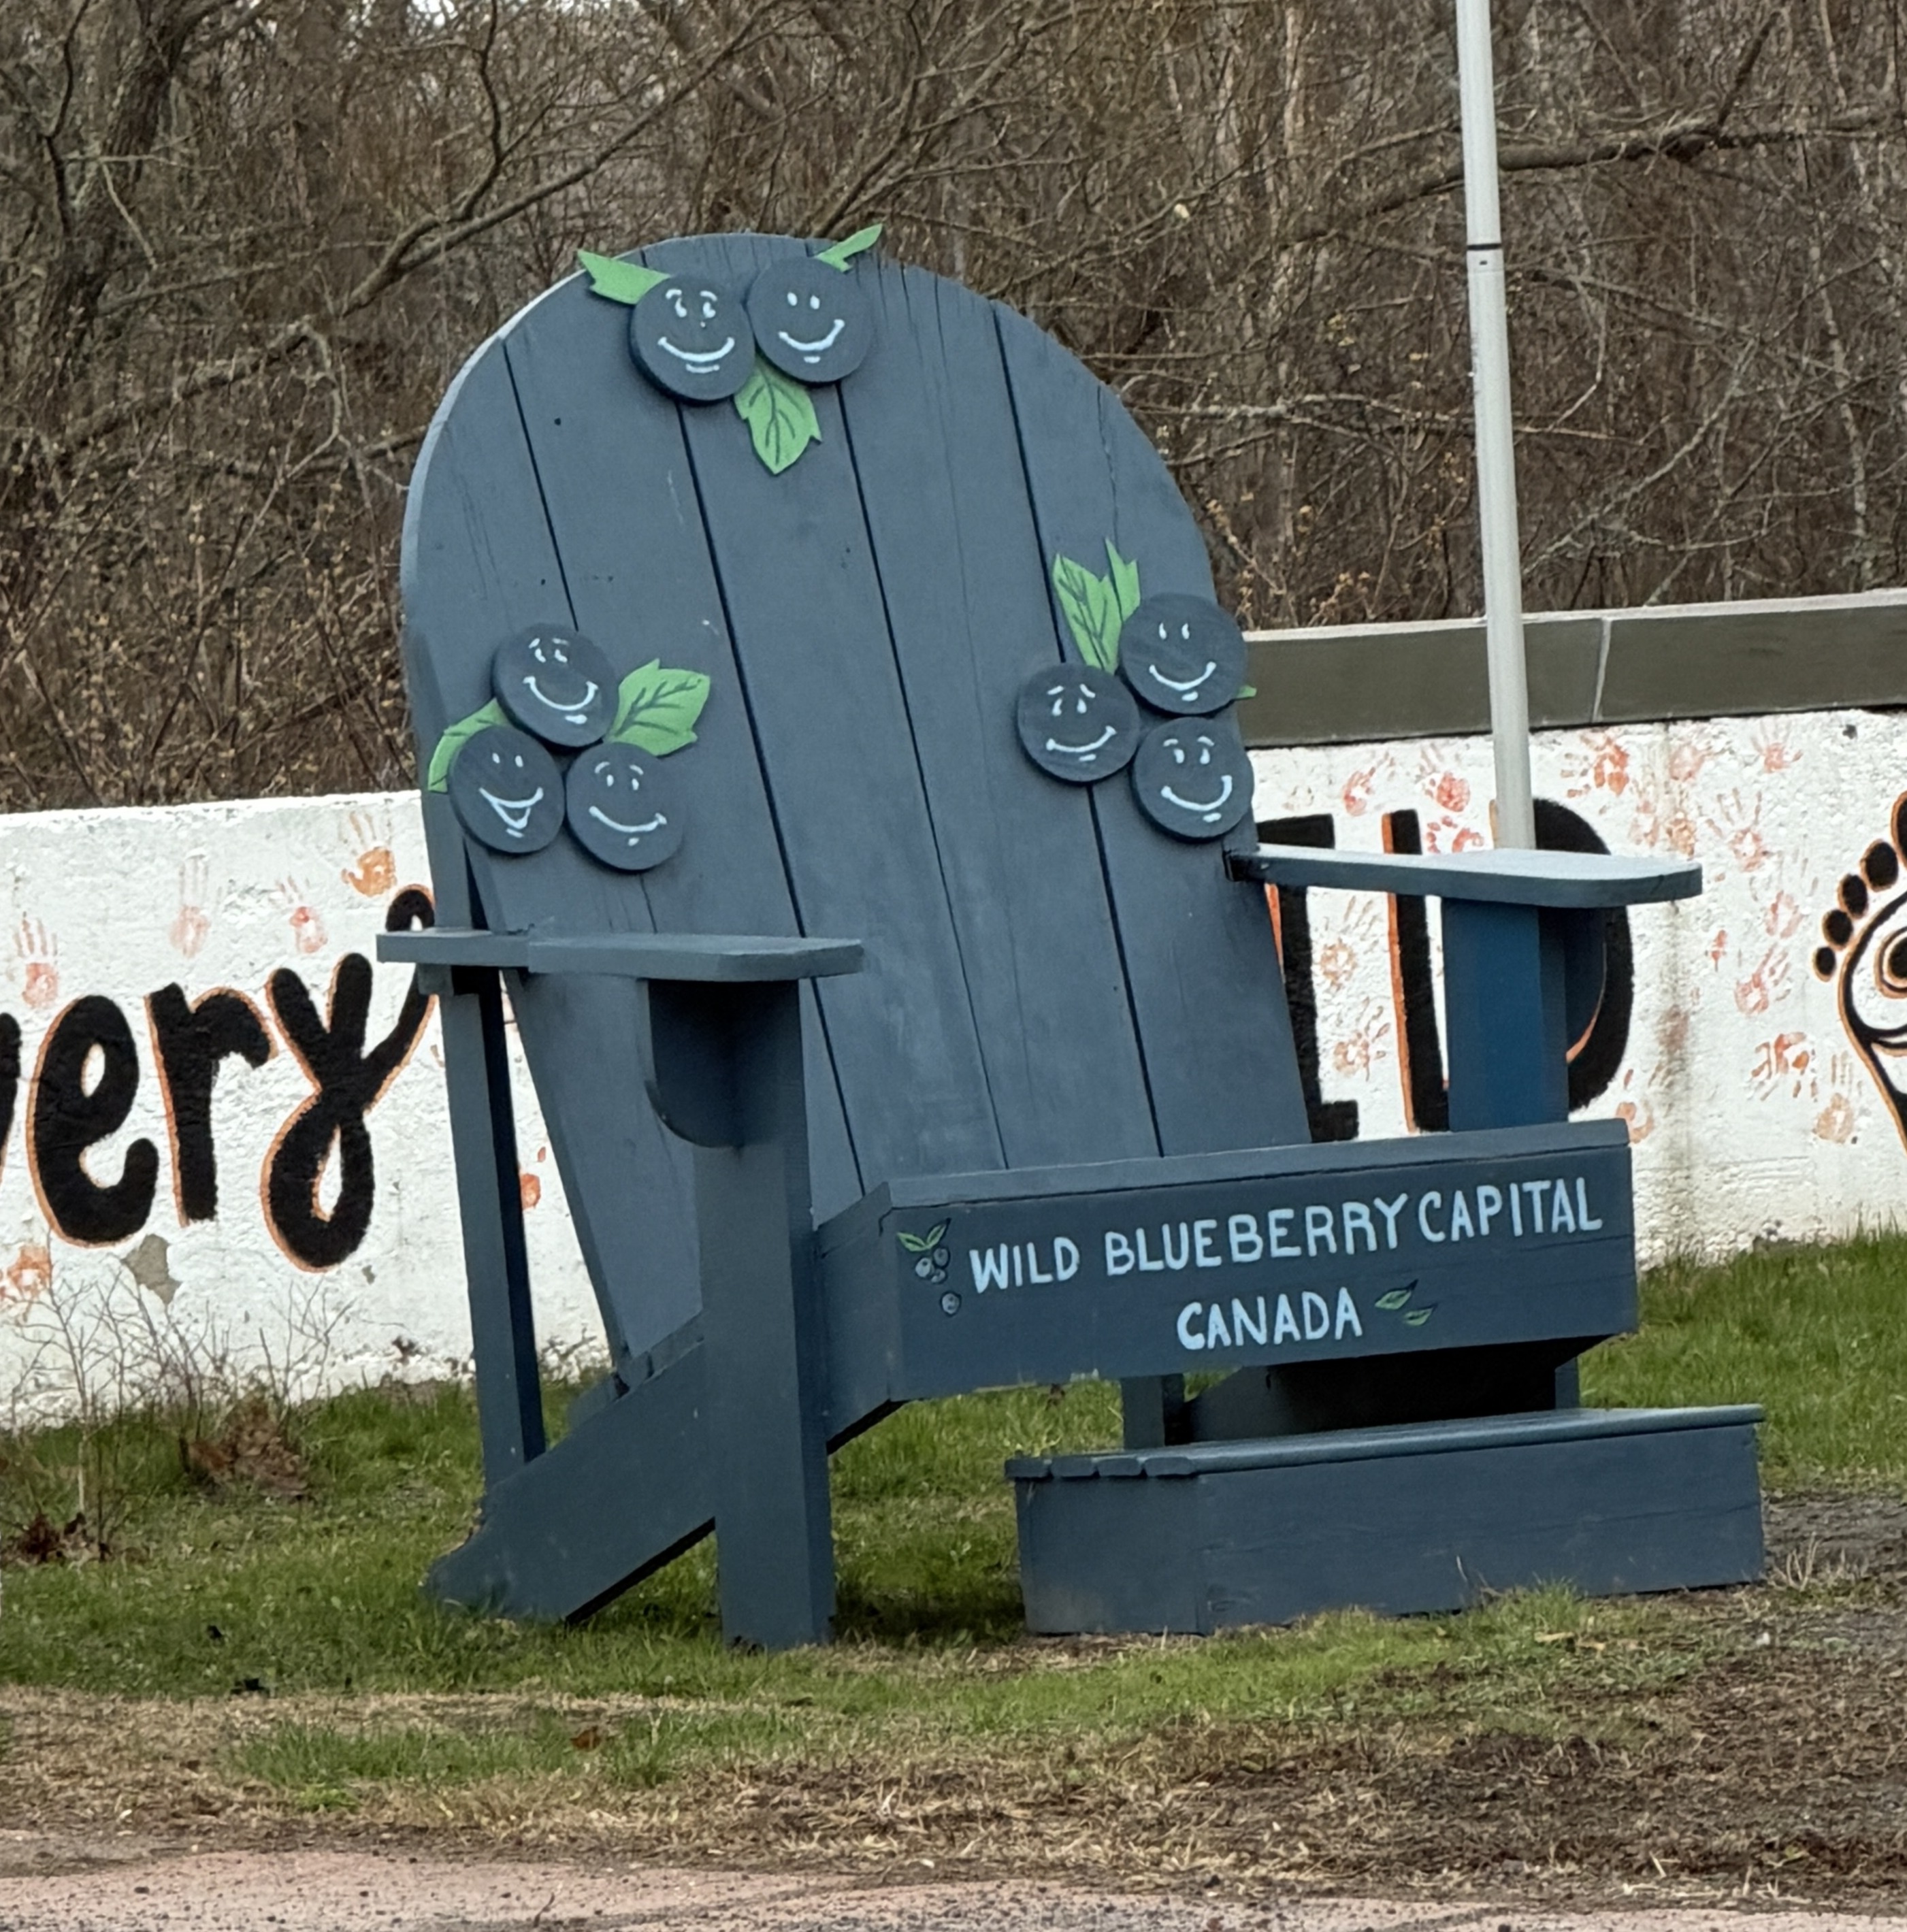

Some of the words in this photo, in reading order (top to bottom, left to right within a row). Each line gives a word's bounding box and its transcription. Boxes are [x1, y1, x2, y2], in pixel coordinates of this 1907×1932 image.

[968, 1237, 1080, 1294] WILD
[1104, 1192, 1409, 1276] BLUEBERRY
[1418, 1177, 1603, 1243] CAPITAL
[1176, 1287, 1363, 1351] CANADA
